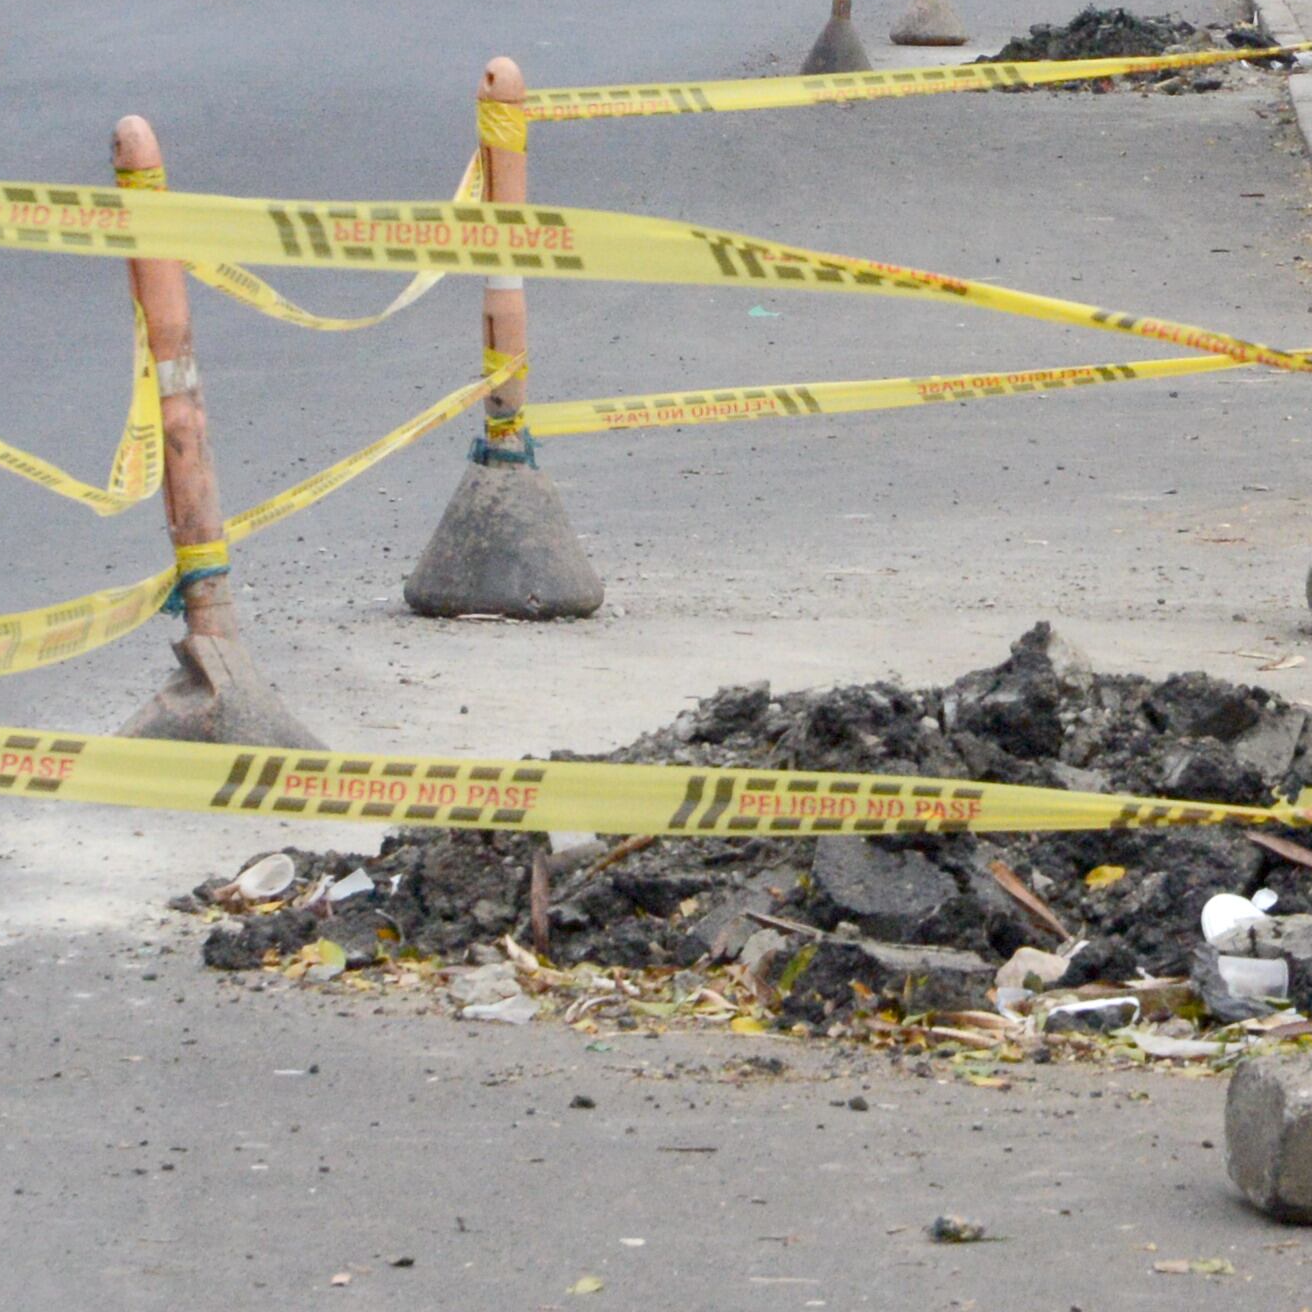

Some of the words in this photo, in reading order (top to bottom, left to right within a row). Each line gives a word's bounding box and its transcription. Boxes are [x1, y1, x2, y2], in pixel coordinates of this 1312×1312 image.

[0, 753, 76, 780] PASE
[284, 774, 408, 803] PELIGRO
[417, 782, 458, 806] NO
[467, 784, 539, 809] PASE
[739, 793, 857, 819] PELIGRO
[866, 798, 906, 819] NO
[914, 798, 982, 821] PASE
